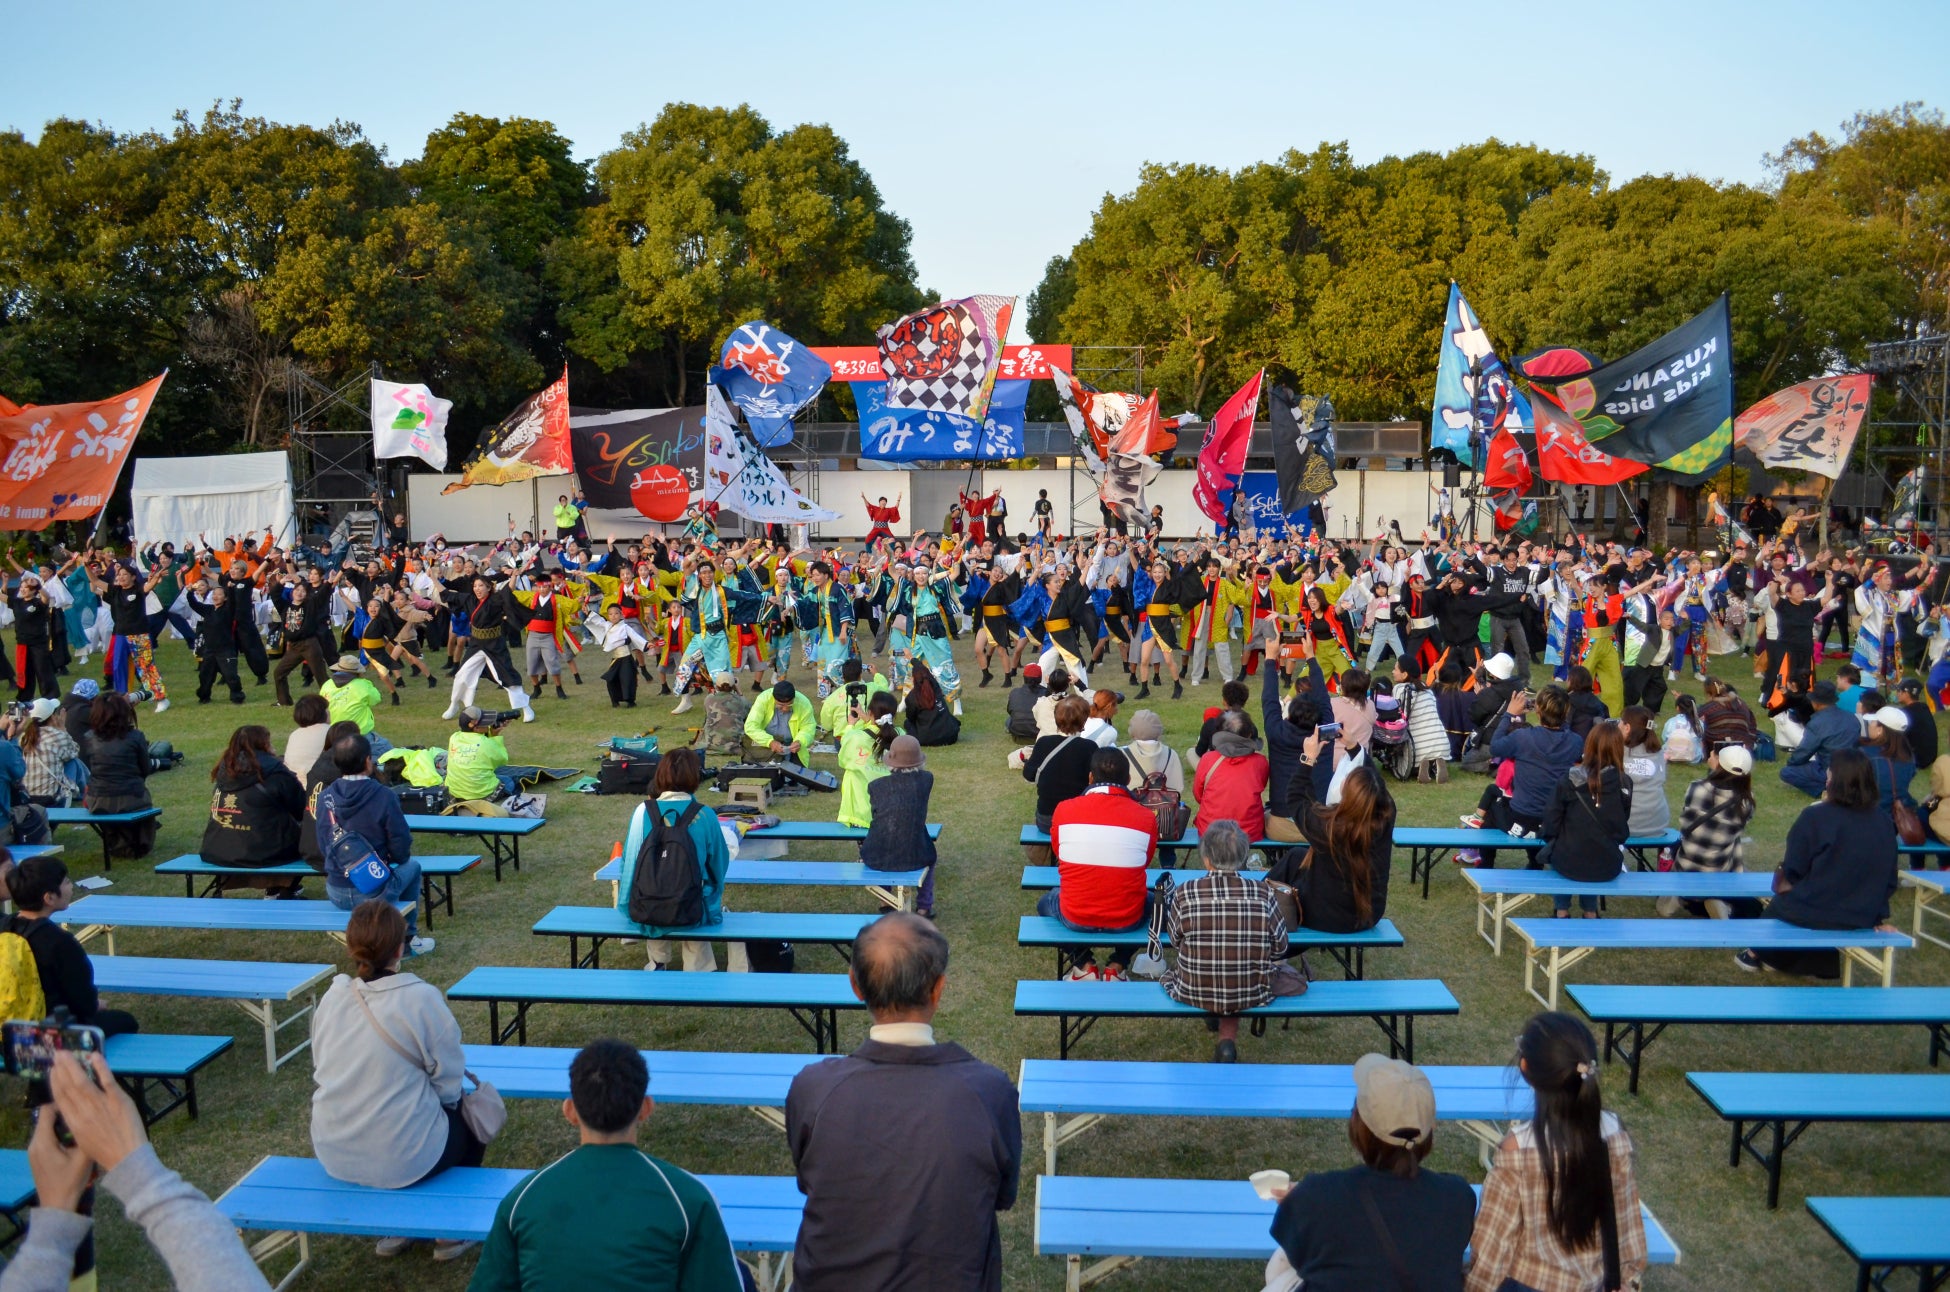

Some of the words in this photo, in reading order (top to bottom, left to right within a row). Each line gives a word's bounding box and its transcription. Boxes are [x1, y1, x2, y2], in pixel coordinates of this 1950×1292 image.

[868, 411, 1017, 459] みづま祭
[629, 466, 702, 489] みづま
[656, 487, 690, 496] mizuma
[1628, 768, 1647, 776] FACE
